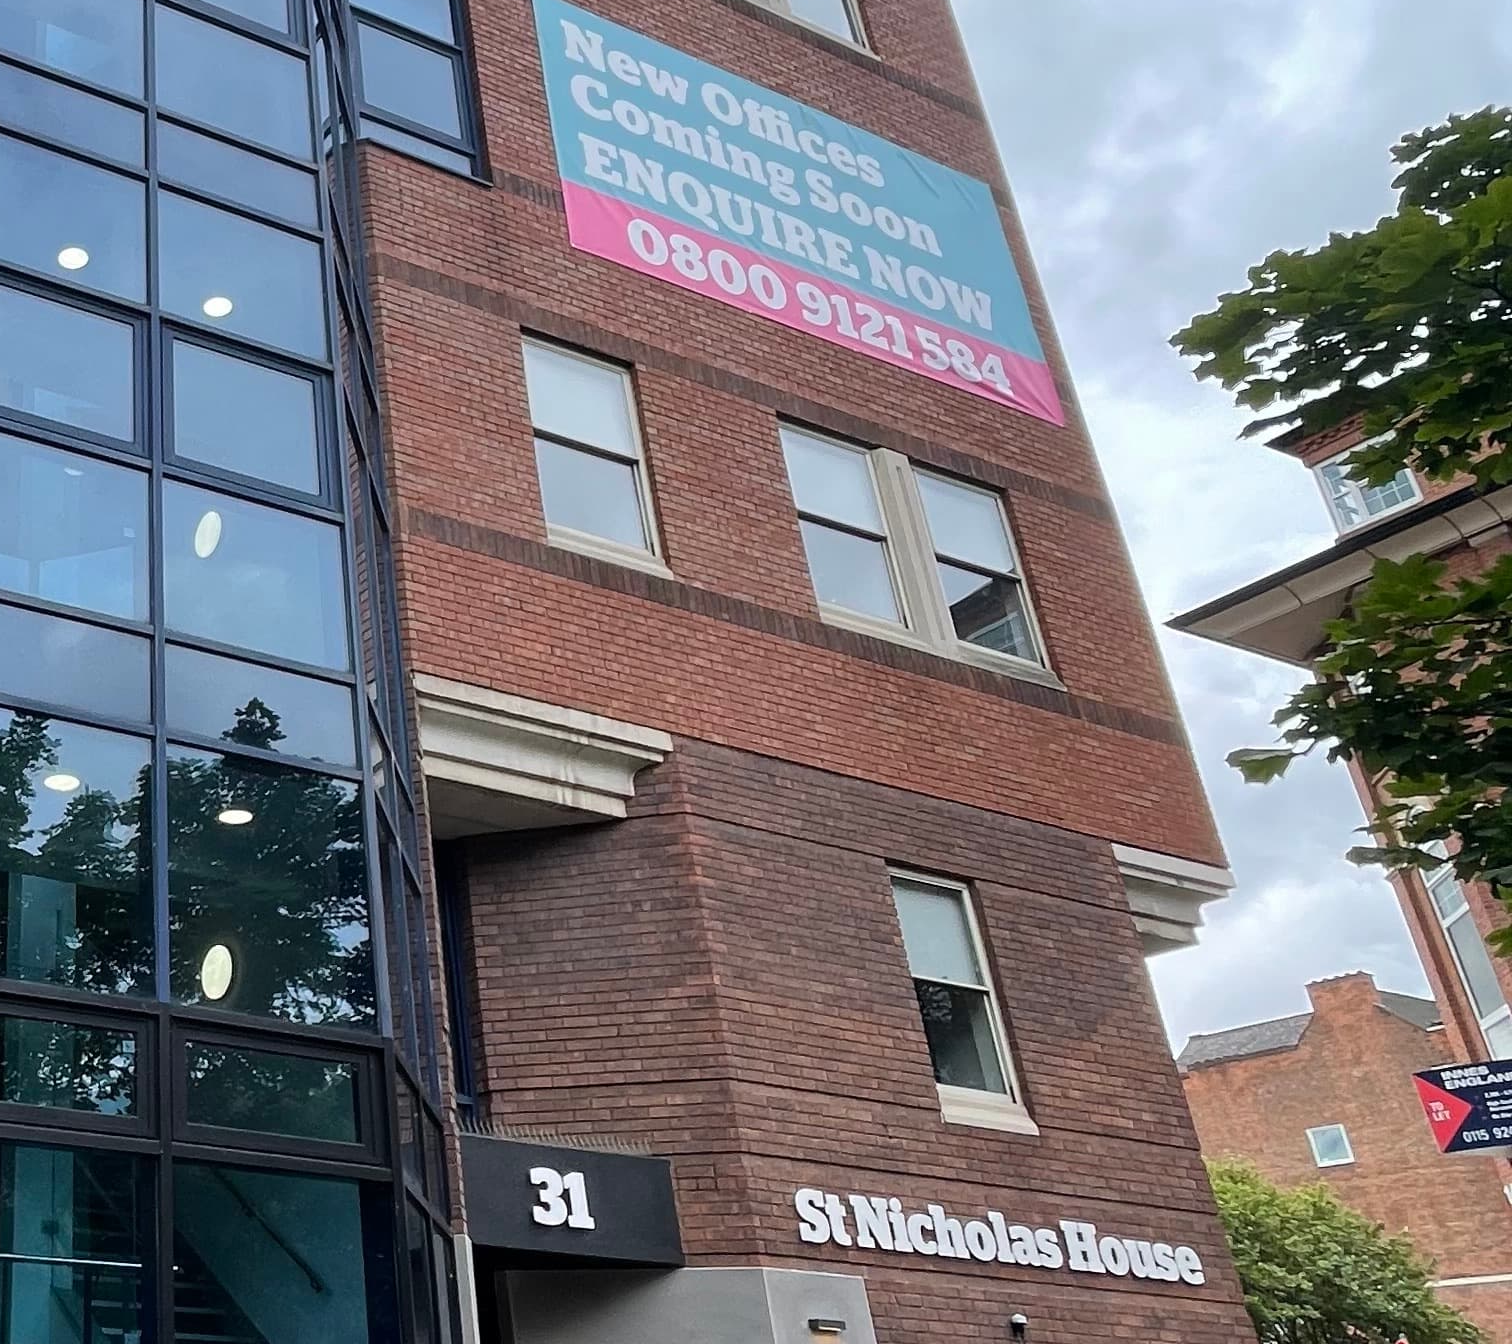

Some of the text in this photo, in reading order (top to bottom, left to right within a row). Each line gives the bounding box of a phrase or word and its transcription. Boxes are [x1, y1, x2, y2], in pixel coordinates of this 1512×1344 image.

[560, 18, 886, 188] New Offices
[570, 74, 943, 257] Coming Soon
[578, 132, 993, 331] ENQUIRE NOW
[627, 217, 1015, 397] 0800 9121 584
[1440, 1065, 1490, 1081] INNES
[1462, 1129, 1490, 1143] 0115
[529, 1166, 596, 1230] 31
[793, 1188, 1206, 1286] St Nicholas House
